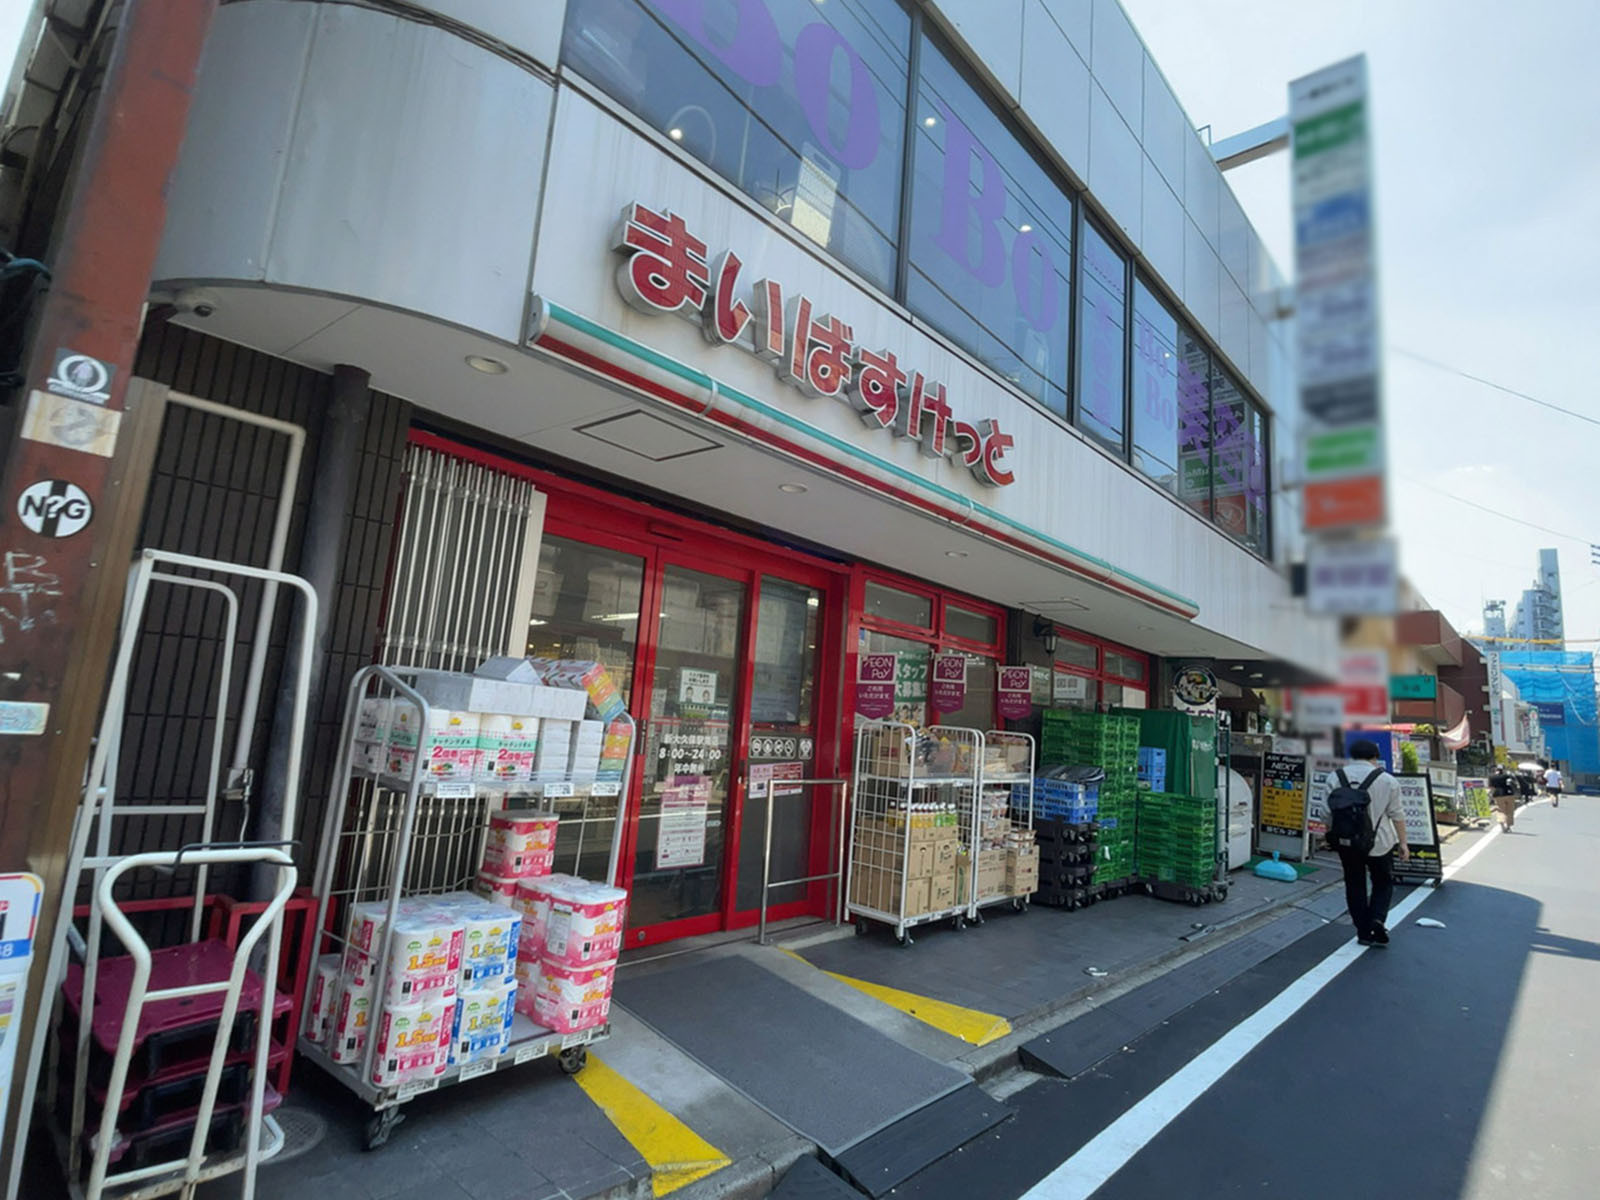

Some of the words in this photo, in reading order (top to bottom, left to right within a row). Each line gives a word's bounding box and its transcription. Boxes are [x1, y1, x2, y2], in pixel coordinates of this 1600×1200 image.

[620, 201, 1015, 487] まいばすけっと
[1271, 762, 1298, 771] NEXT
